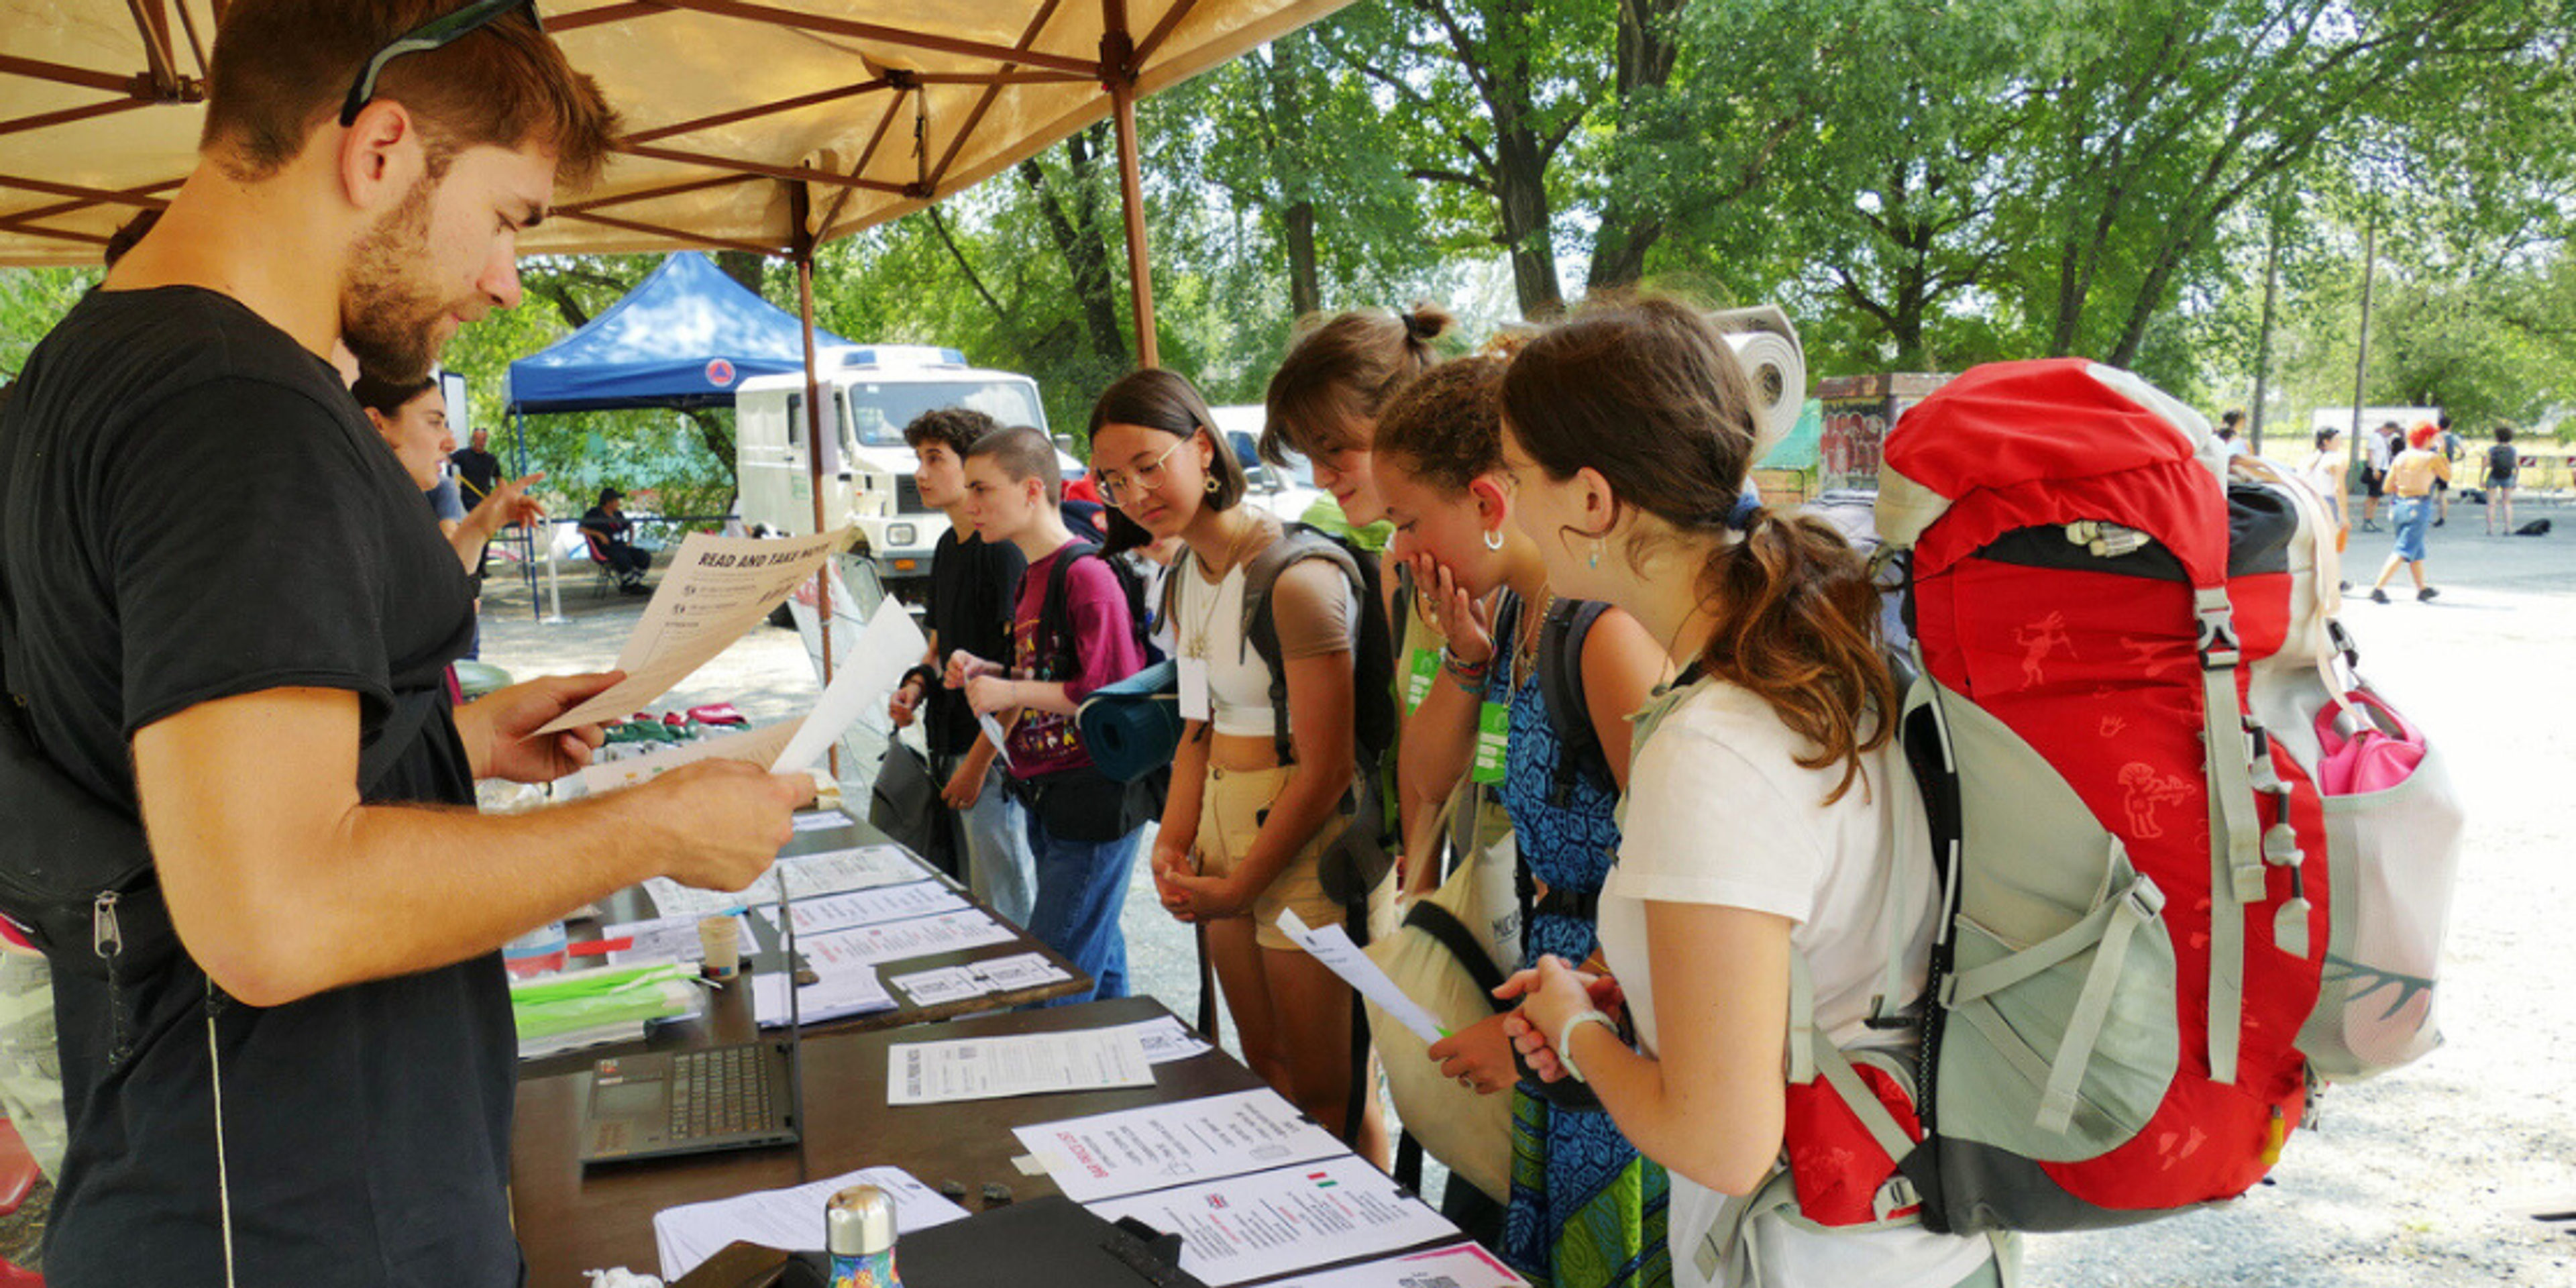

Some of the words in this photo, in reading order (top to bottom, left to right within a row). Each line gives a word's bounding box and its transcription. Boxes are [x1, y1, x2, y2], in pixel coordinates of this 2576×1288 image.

[698, 552, 736, 568] READ
[737, 554, 767, 568] AND
[768, 550, 800, 565] TAKE
